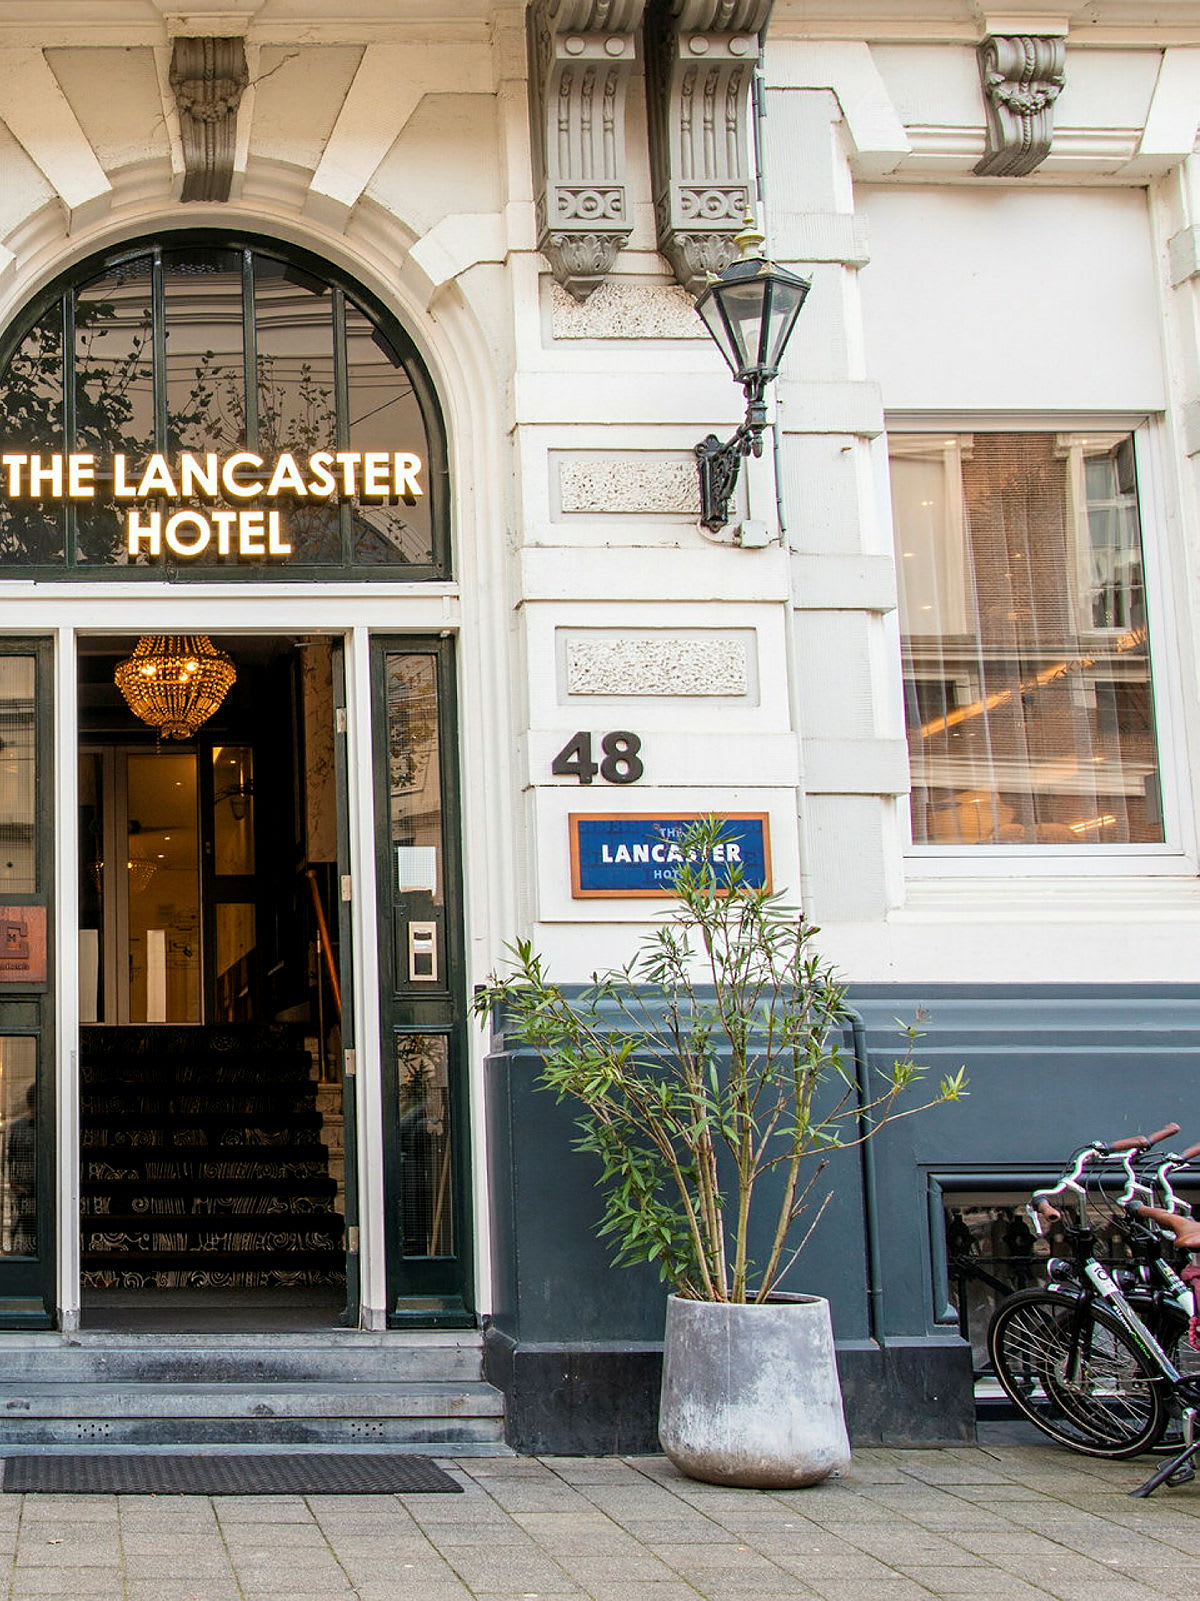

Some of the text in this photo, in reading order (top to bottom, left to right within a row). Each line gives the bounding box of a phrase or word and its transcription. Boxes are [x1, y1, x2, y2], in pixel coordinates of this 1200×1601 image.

[2, 452, 424, 498] THE LANCASTER
[128, 511, 292, 556] HOTEL
[551, 731, 644, 784] 48
